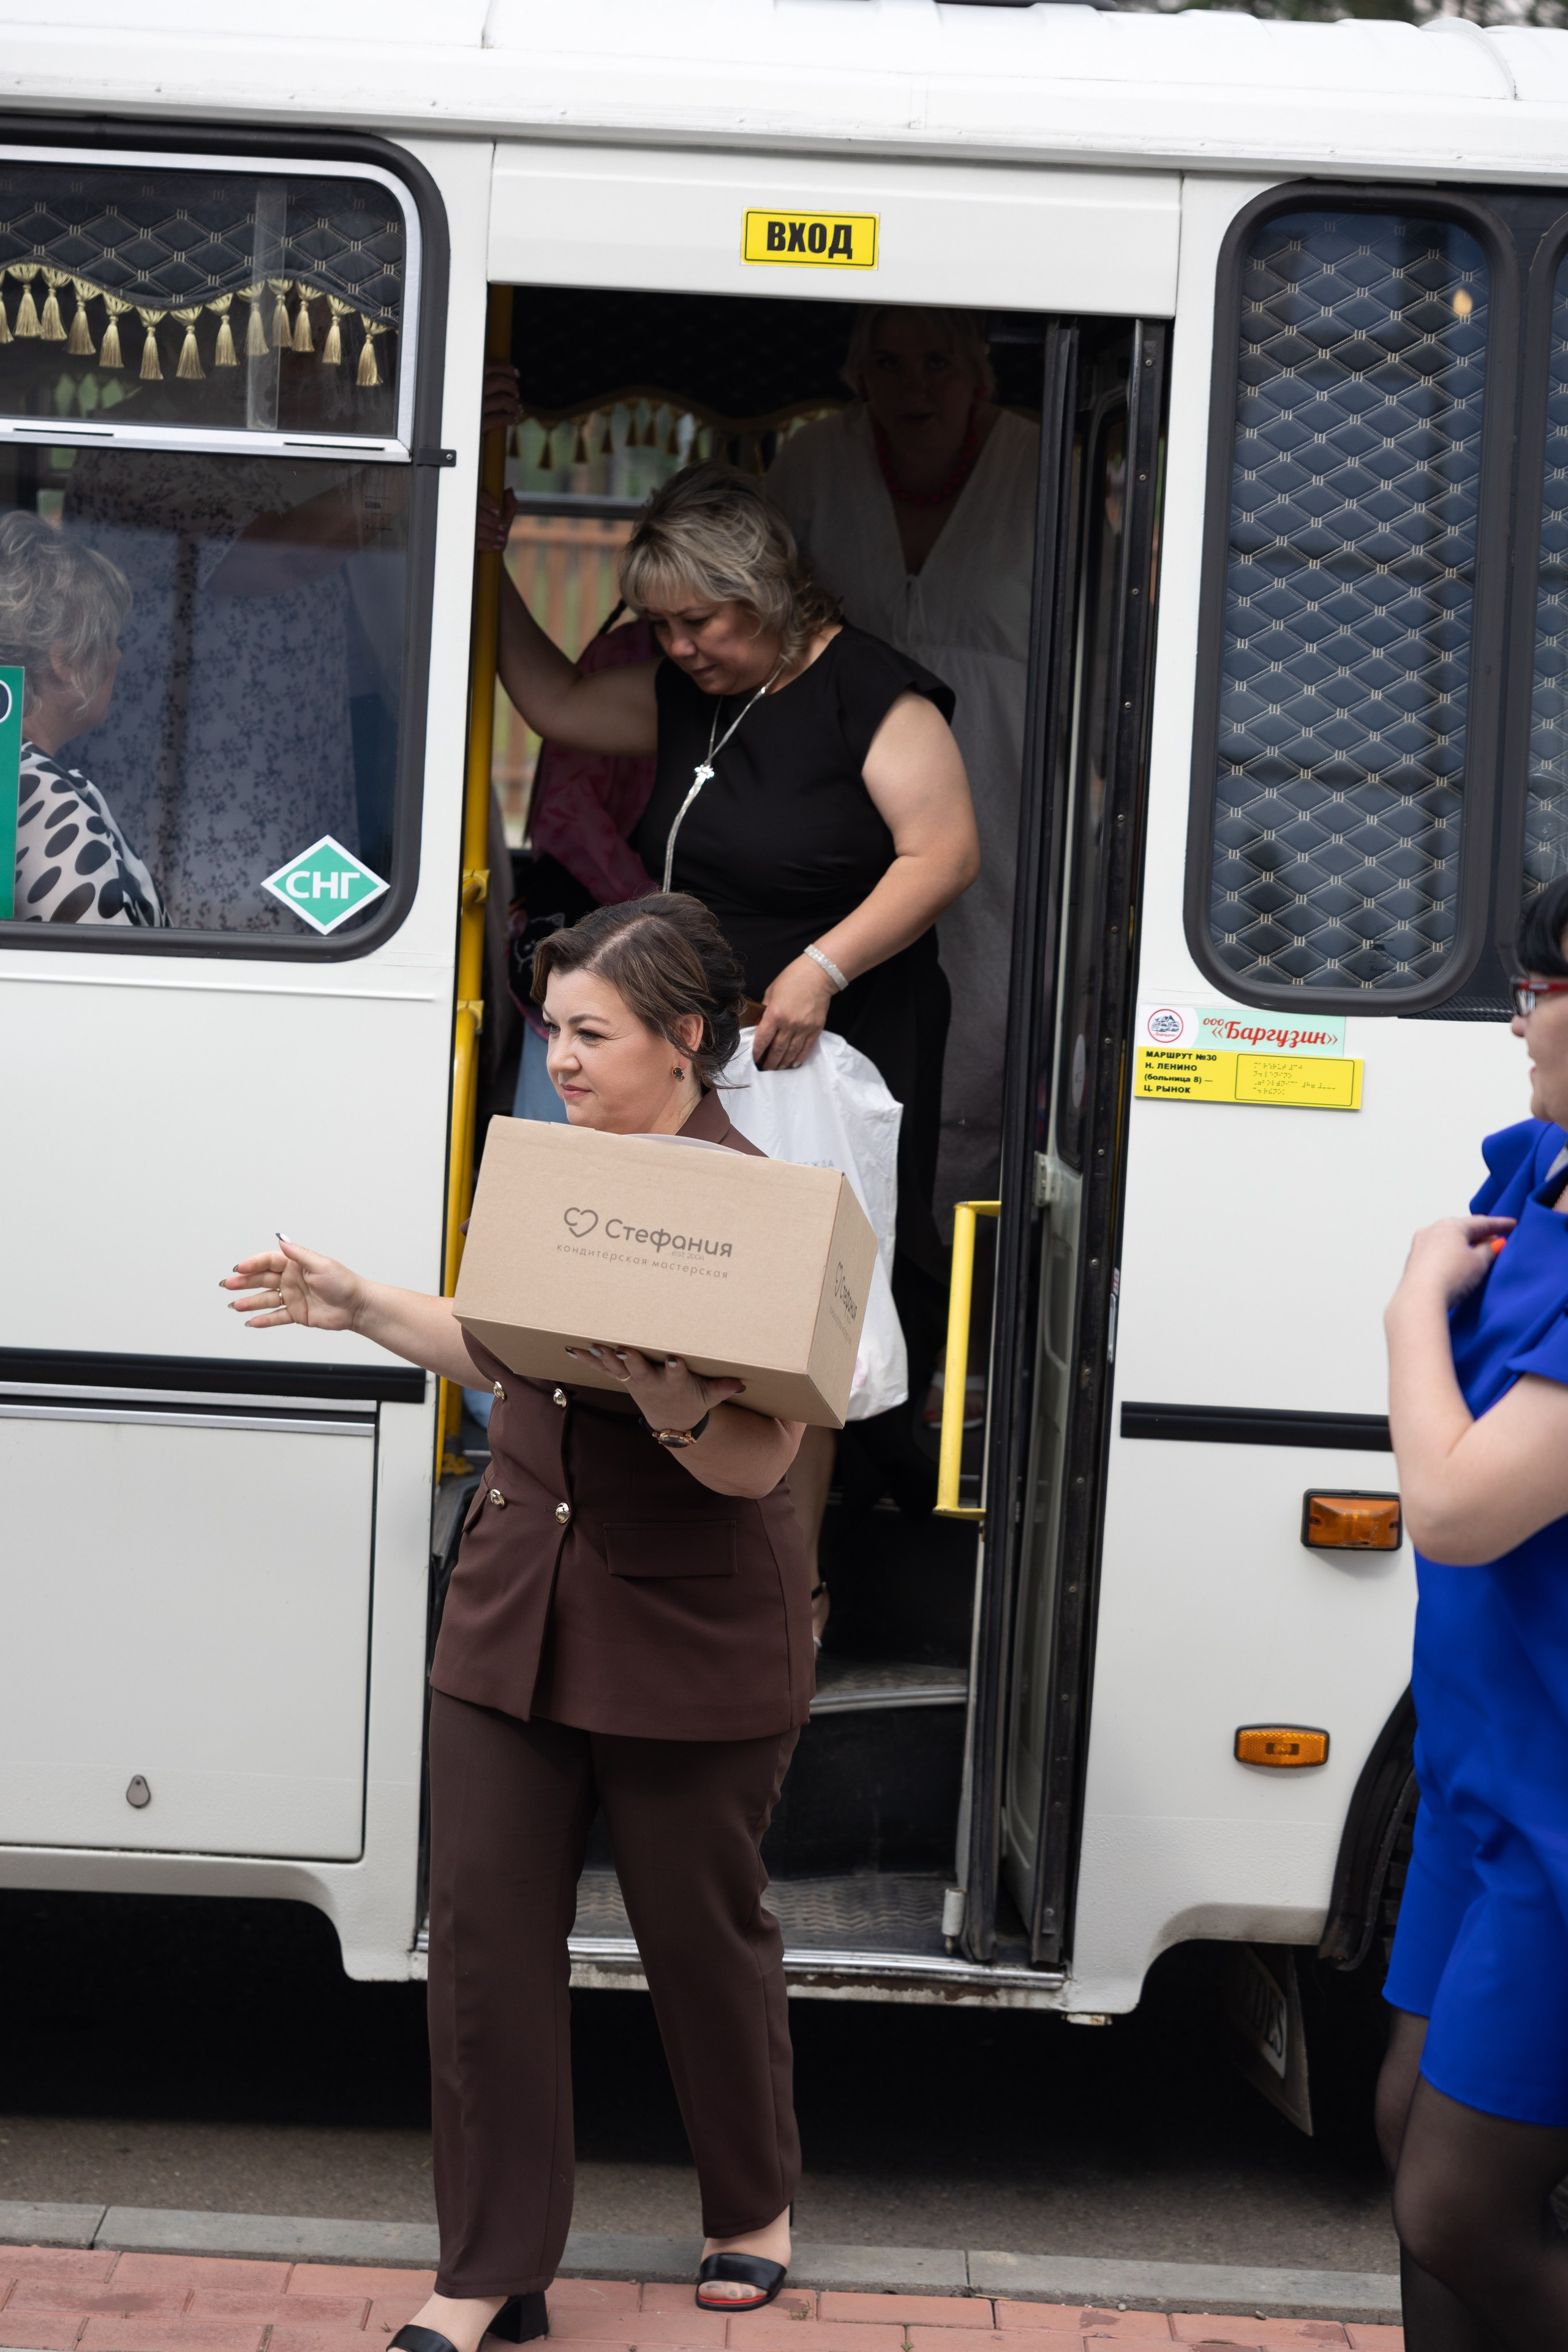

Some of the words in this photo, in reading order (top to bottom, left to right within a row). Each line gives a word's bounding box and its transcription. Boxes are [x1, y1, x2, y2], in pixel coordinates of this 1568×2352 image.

[767, 221, 853, 259] ВХОД
[285, 870, 360, 899] СНГ
[1146, 1051, 1193, 1060] МАРШРУТ
[1157, 1063, 1197, 1071] ЛЕНИНО
[1144, 1074, 1191, 1083] (больница
[605, 1219, 733, 1257] Стефания
[556, 1244, 647, 1265] кондитерская
[652, 1261, 728, 1279] мастерская
